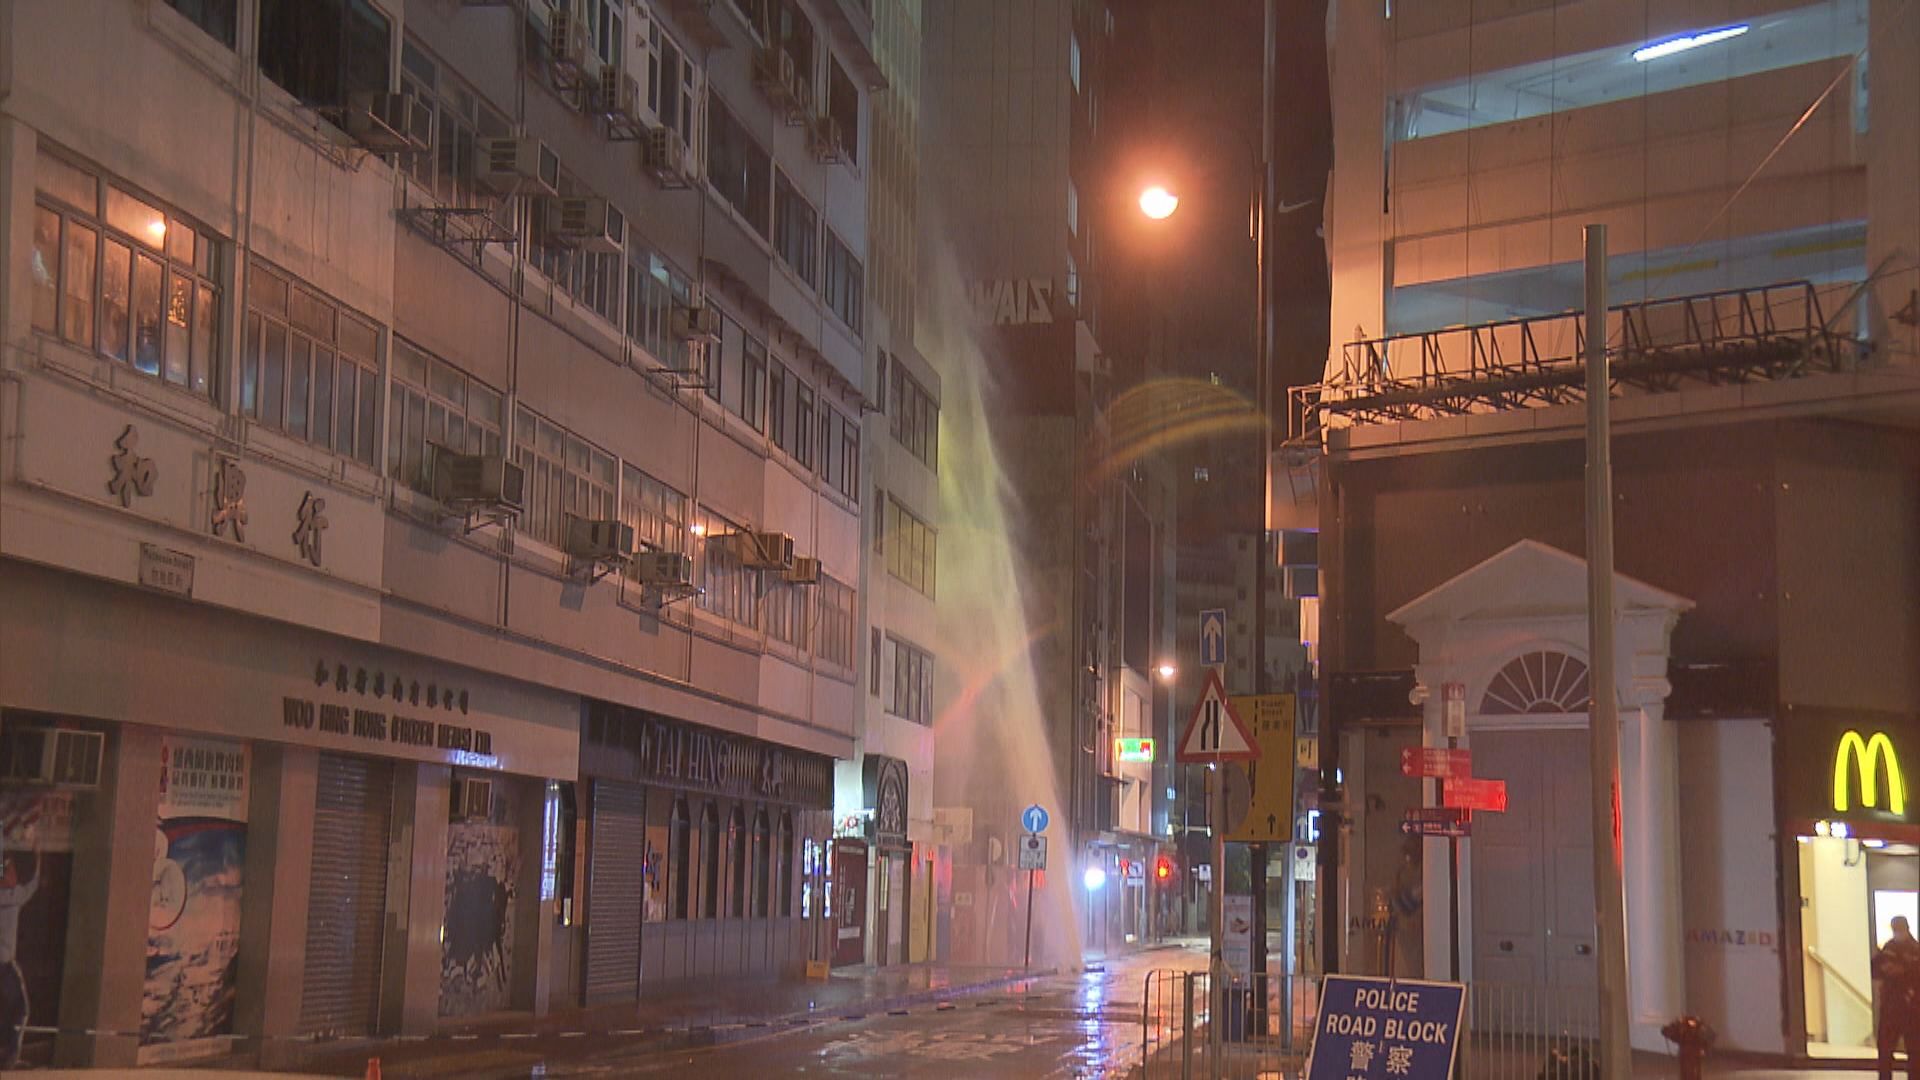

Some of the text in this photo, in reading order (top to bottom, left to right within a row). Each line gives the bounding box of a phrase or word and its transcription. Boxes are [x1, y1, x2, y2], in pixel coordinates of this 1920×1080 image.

[283, 696, 315, 730] WOO
[353, 708, 387, 743] HONG
[654, 722, 729, 788] TAI HING
[1354, 988, 1420, 1013] POLICE
[1325, 1013, 1448, 1044] ROAD BLOCK
[1349, 1040, 1413, 1075] 警察
